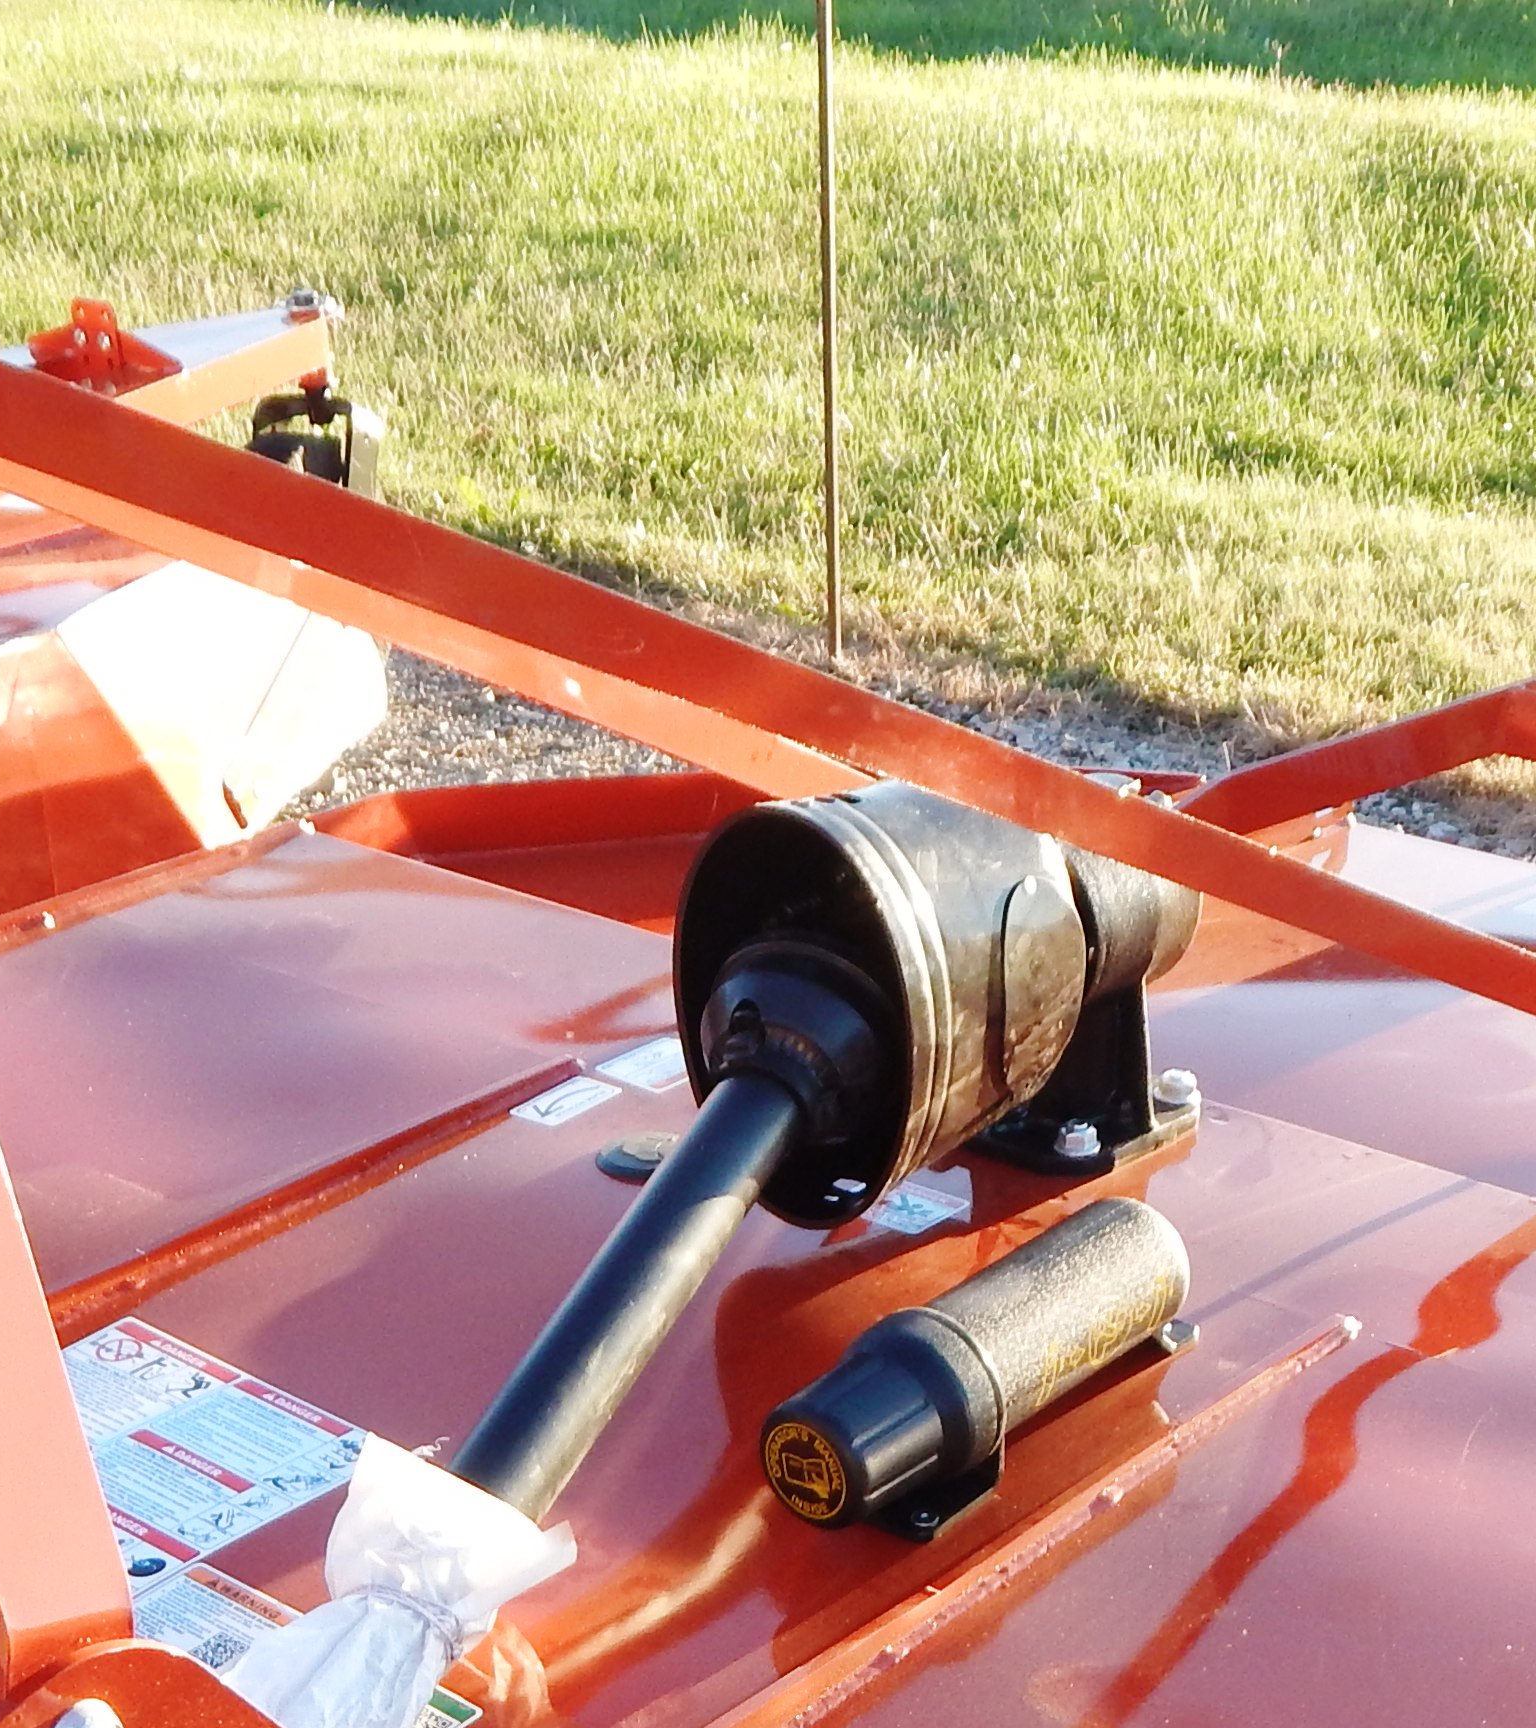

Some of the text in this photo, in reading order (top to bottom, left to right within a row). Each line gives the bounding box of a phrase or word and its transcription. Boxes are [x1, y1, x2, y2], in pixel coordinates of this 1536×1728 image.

[163, 1340, 208, 1368] DANGER
[276, 1396, 322, 1423] DANGER
[173, 1447, 223, 1477] DANGER
[111, 1511, 148, 1537] ANGER
[216, 1579, 283, 1621] WARNING
